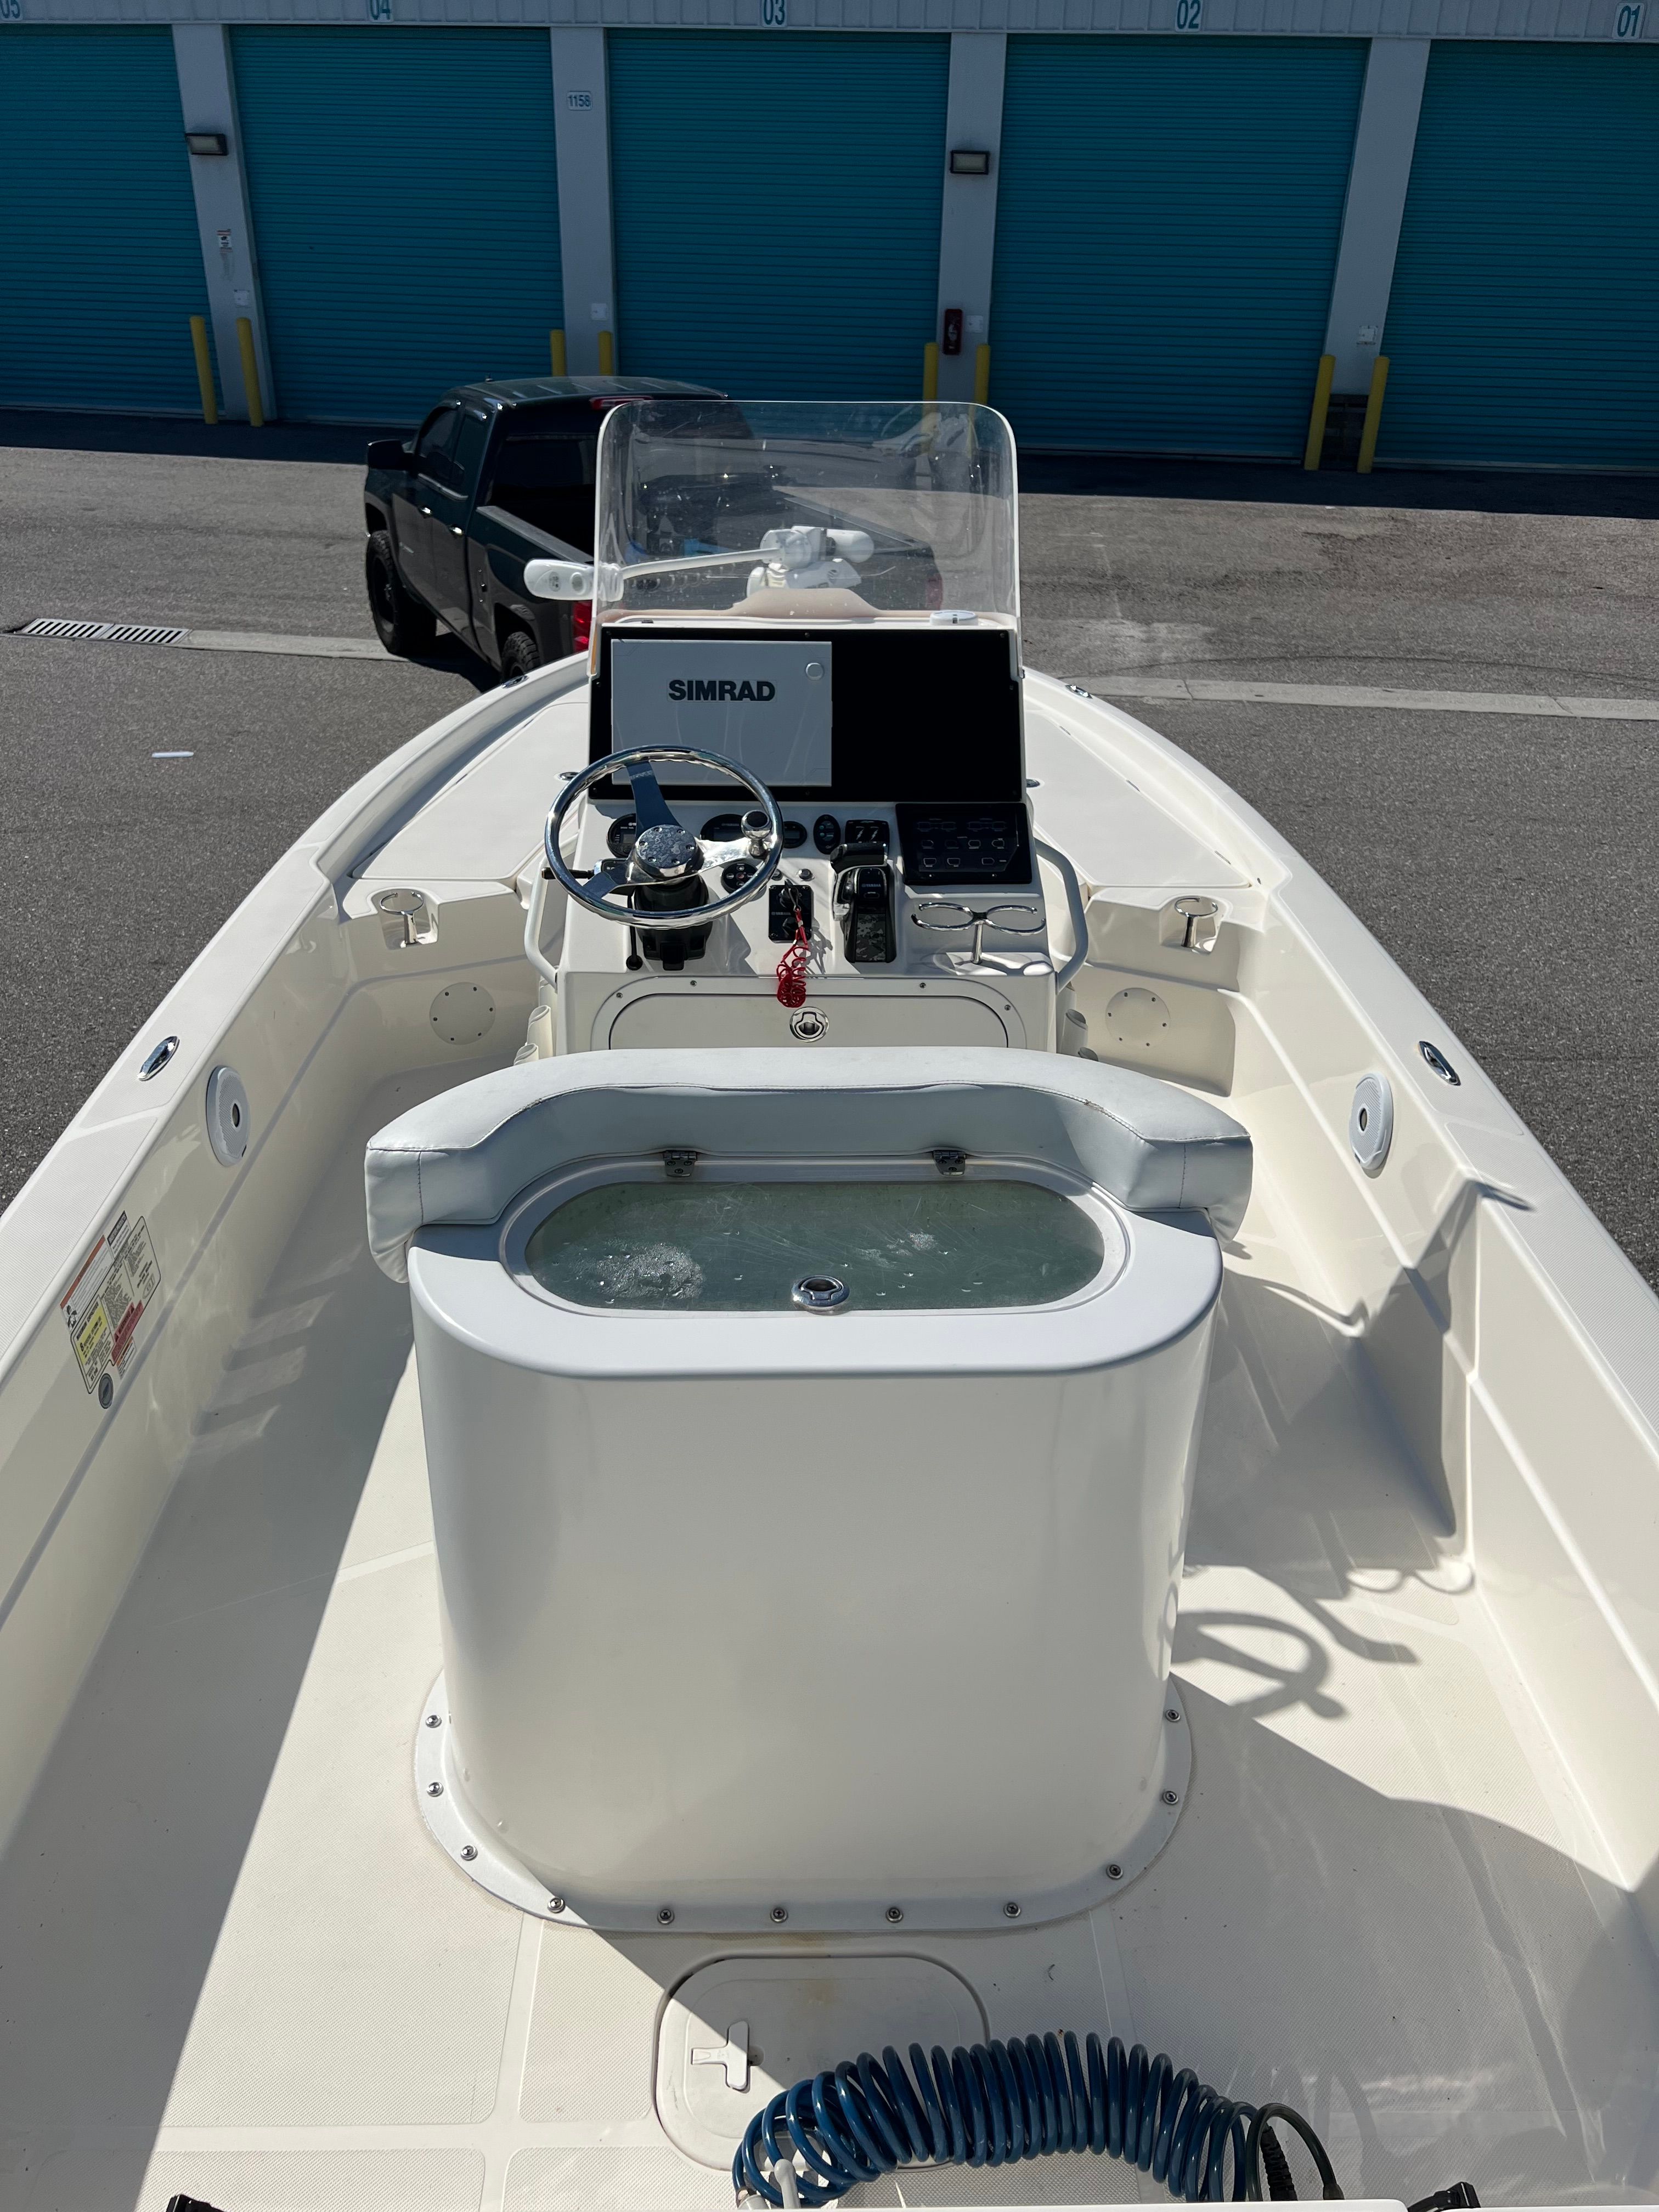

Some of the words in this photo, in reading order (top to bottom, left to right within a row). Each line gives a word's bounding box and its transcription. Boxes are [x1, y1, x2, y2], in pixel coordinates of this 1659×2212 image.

[0, 0, 20, 19] 05
[370, 0, 391, 20] 04
[764, 0, 785, 25] 03
[1177, 0, 1201, 30] 02
[1617, 5, 1641, 37] 01
[567, 94, 591, 107] 1158
[668, 679, 776, 702] SIMRAD
[80, 1342, 84, 1352] 8
